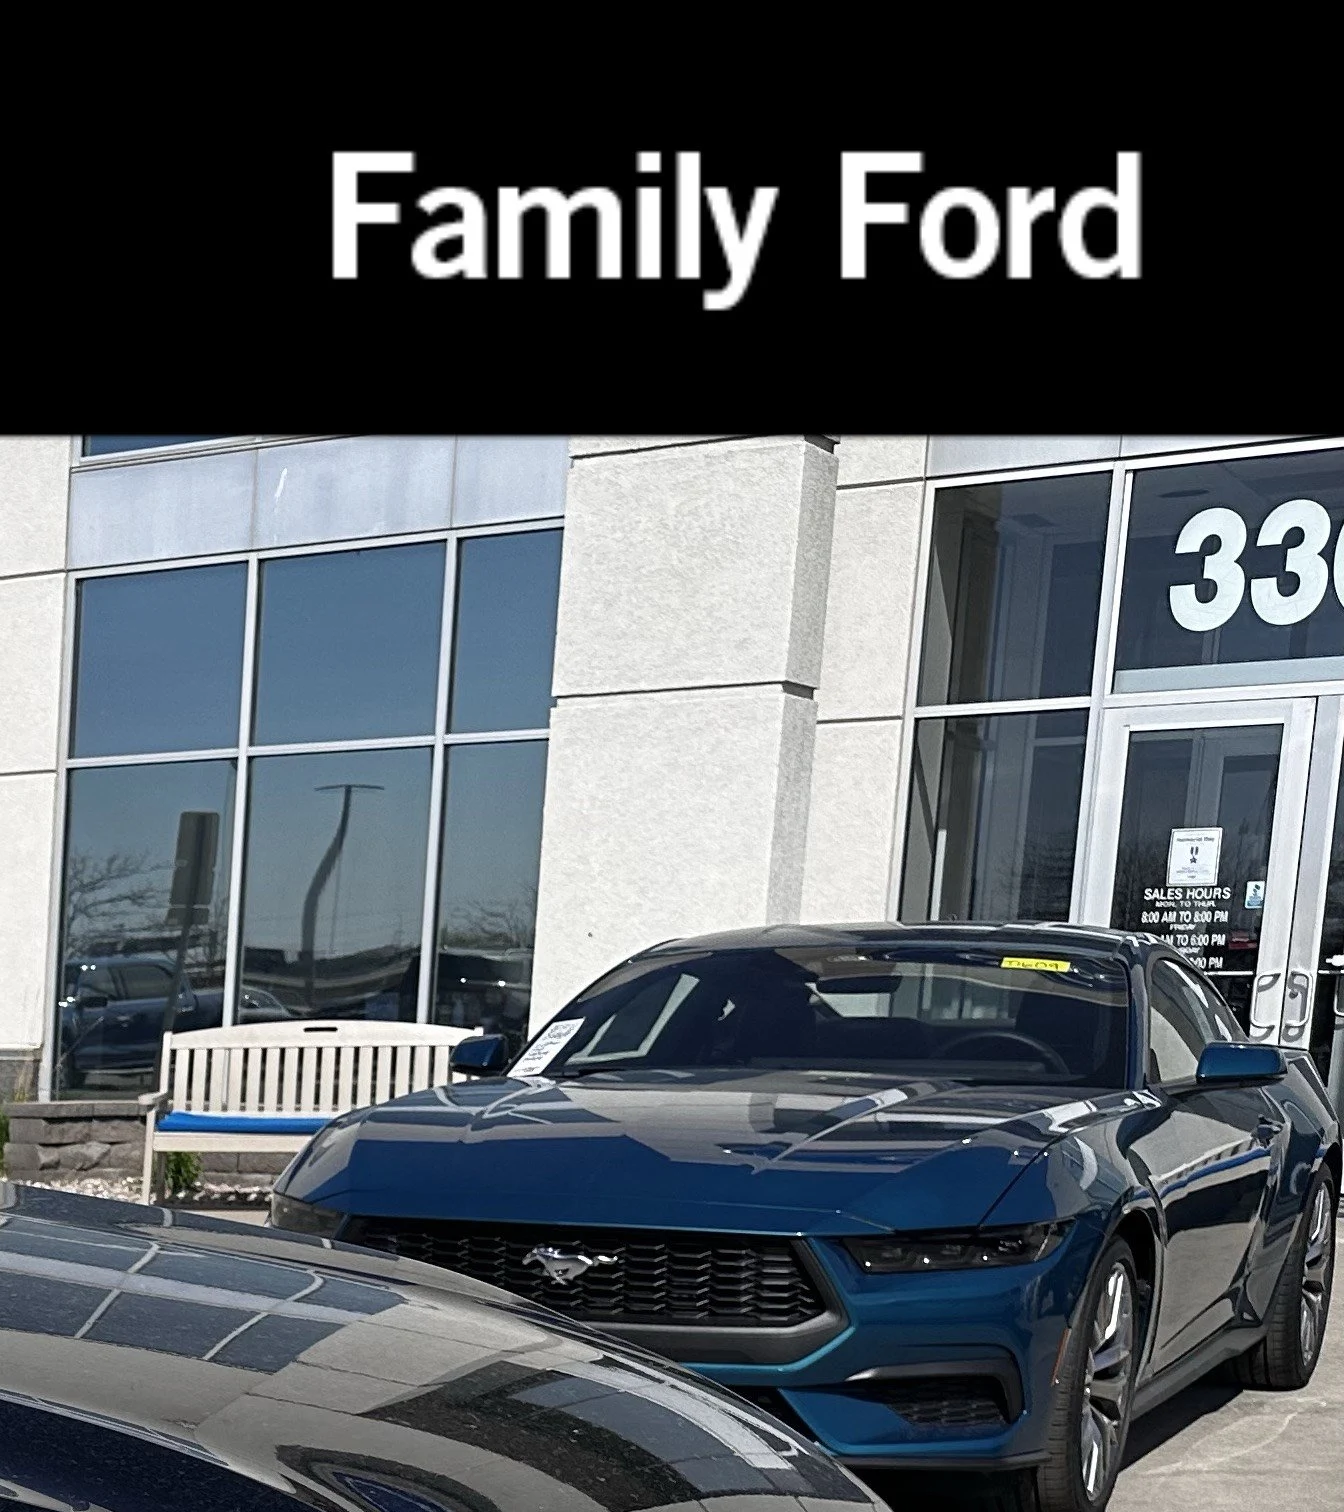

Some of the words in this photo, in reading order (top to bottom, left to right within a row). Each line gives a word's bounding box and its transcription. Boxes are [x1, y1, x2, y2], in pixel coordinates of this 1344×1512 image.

[1169, 498, 1344, 632] 33
[1144, 887, 1183, 900] SALES
[1186, 887, 1231, 900] HOURS
[1180, 900, 1192, 908] TO
[1141, 911, 1160, 924] 8:00
[1161, 911, 1177, 924] AM
[1179, 911, 1192, 924] TO
[1193, 911, 1213, 924] 8:00
[1214, 911, 1229, 923] PM
[1176, 934, 1189, 946] TO
[1190, 934, 1210, 946] 6:00
[1211, 934, 1226, 946] PM
[1208, 956, 1224, 969] PM
